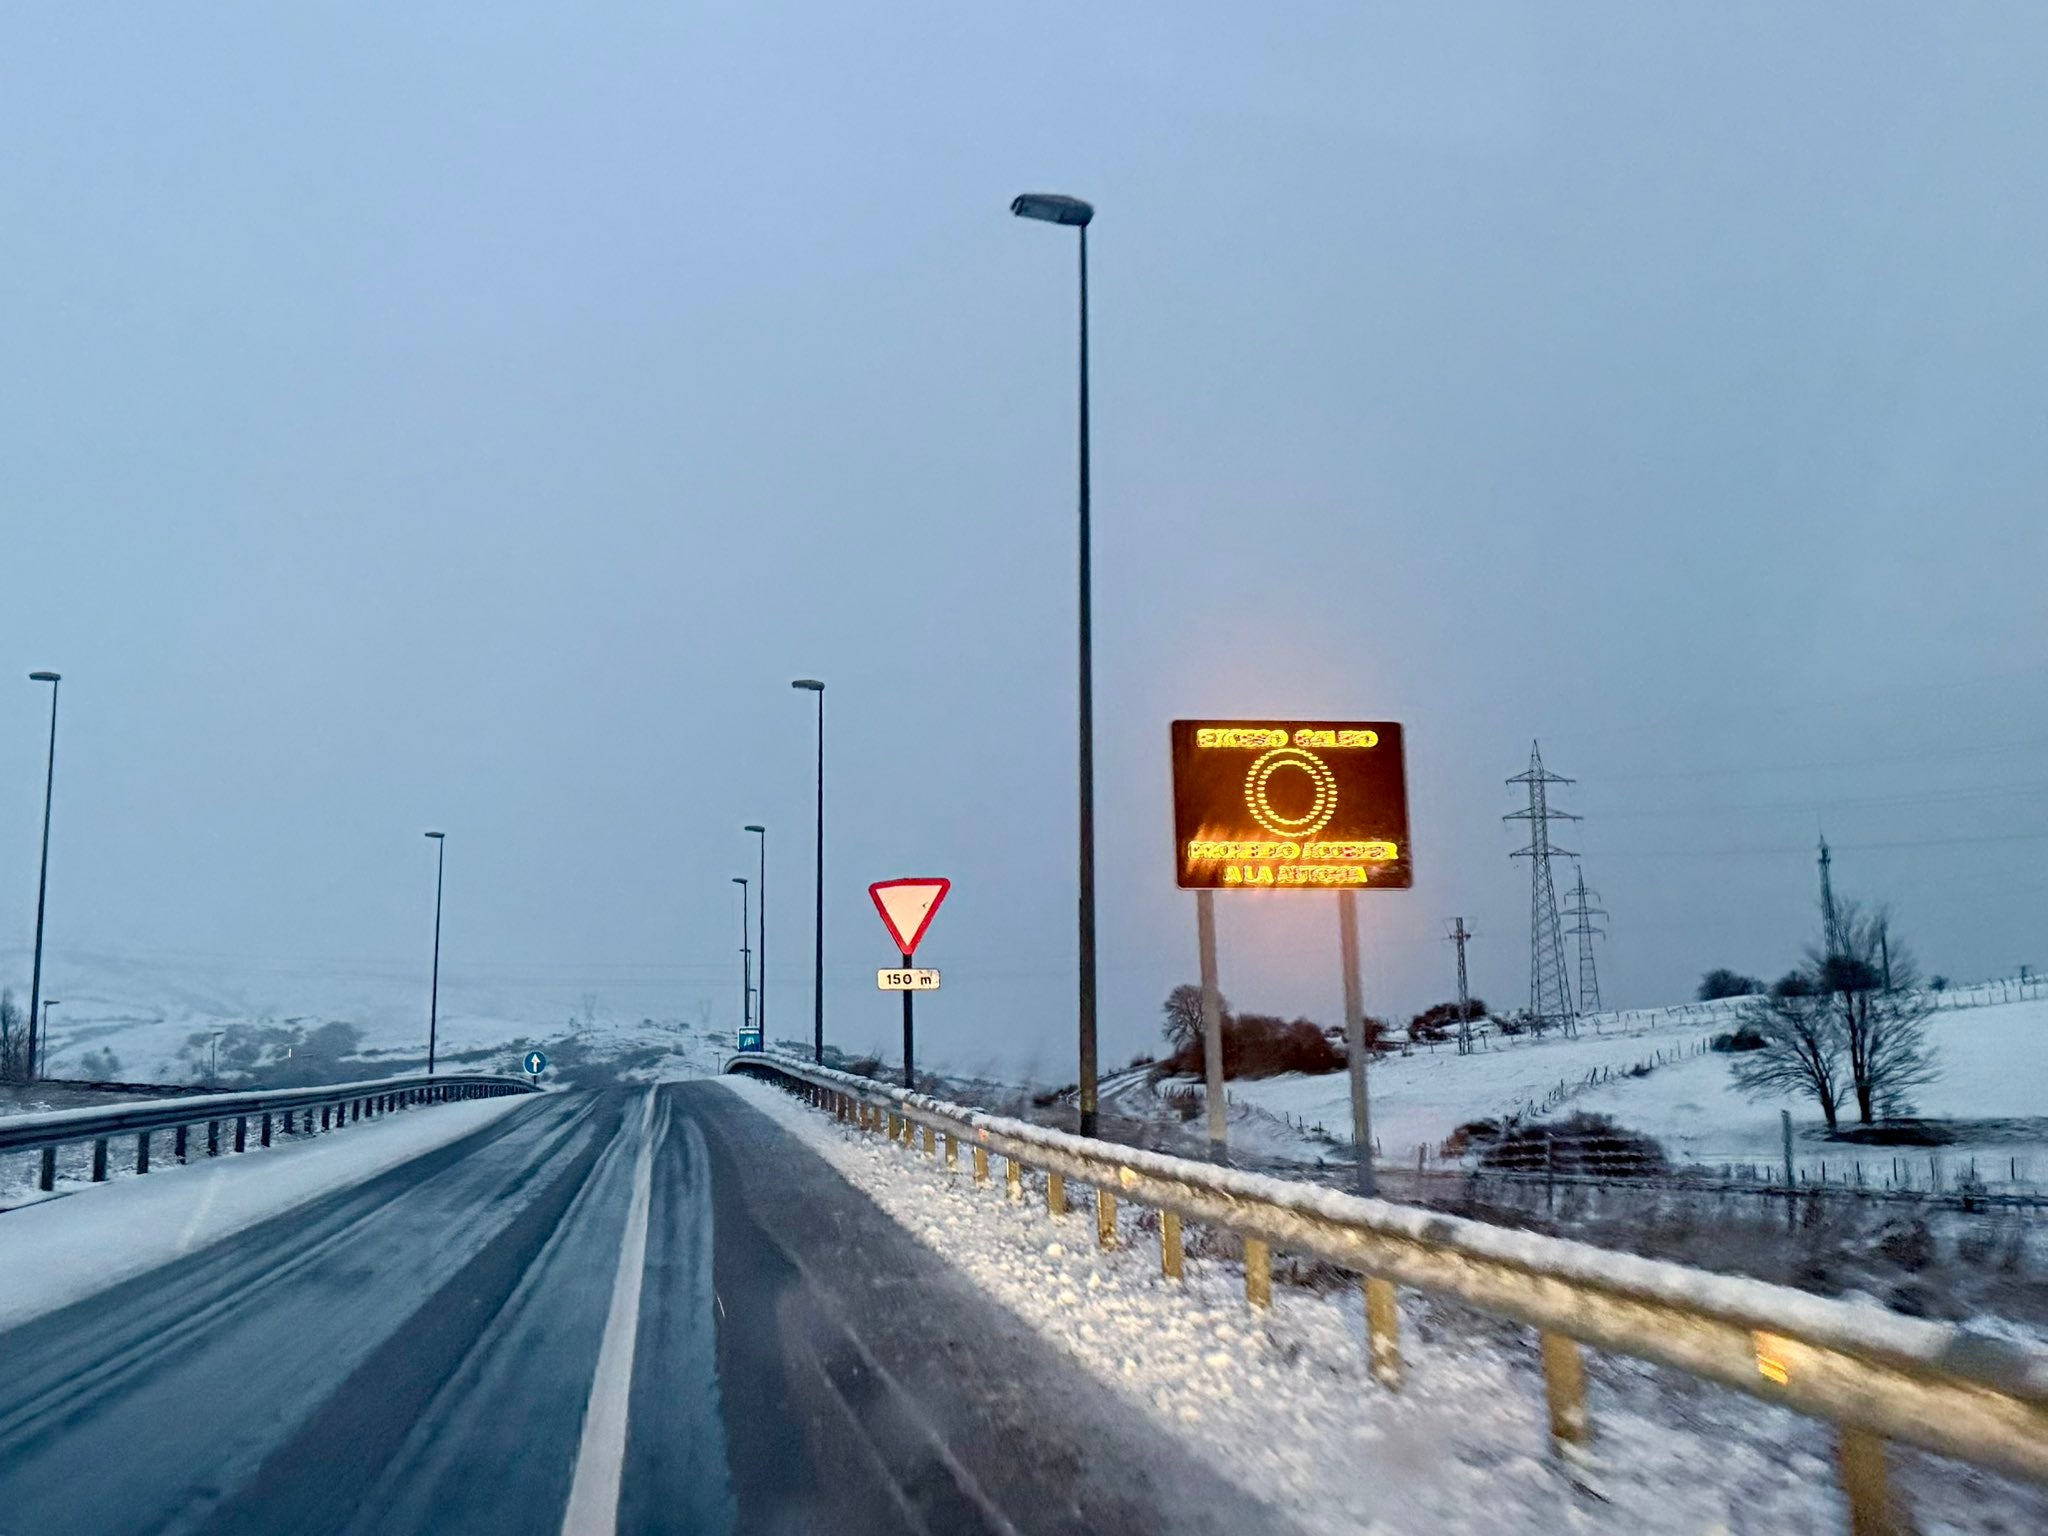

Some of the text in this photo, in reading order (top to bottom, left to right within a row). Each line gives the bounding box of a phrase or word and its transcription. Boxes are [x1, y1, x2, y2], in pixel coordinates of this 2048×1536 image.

[1224, 865, 1242, 883] A
[1243, 865, 1274, 883] LA
[886, 973, 932, 985] 150 m
